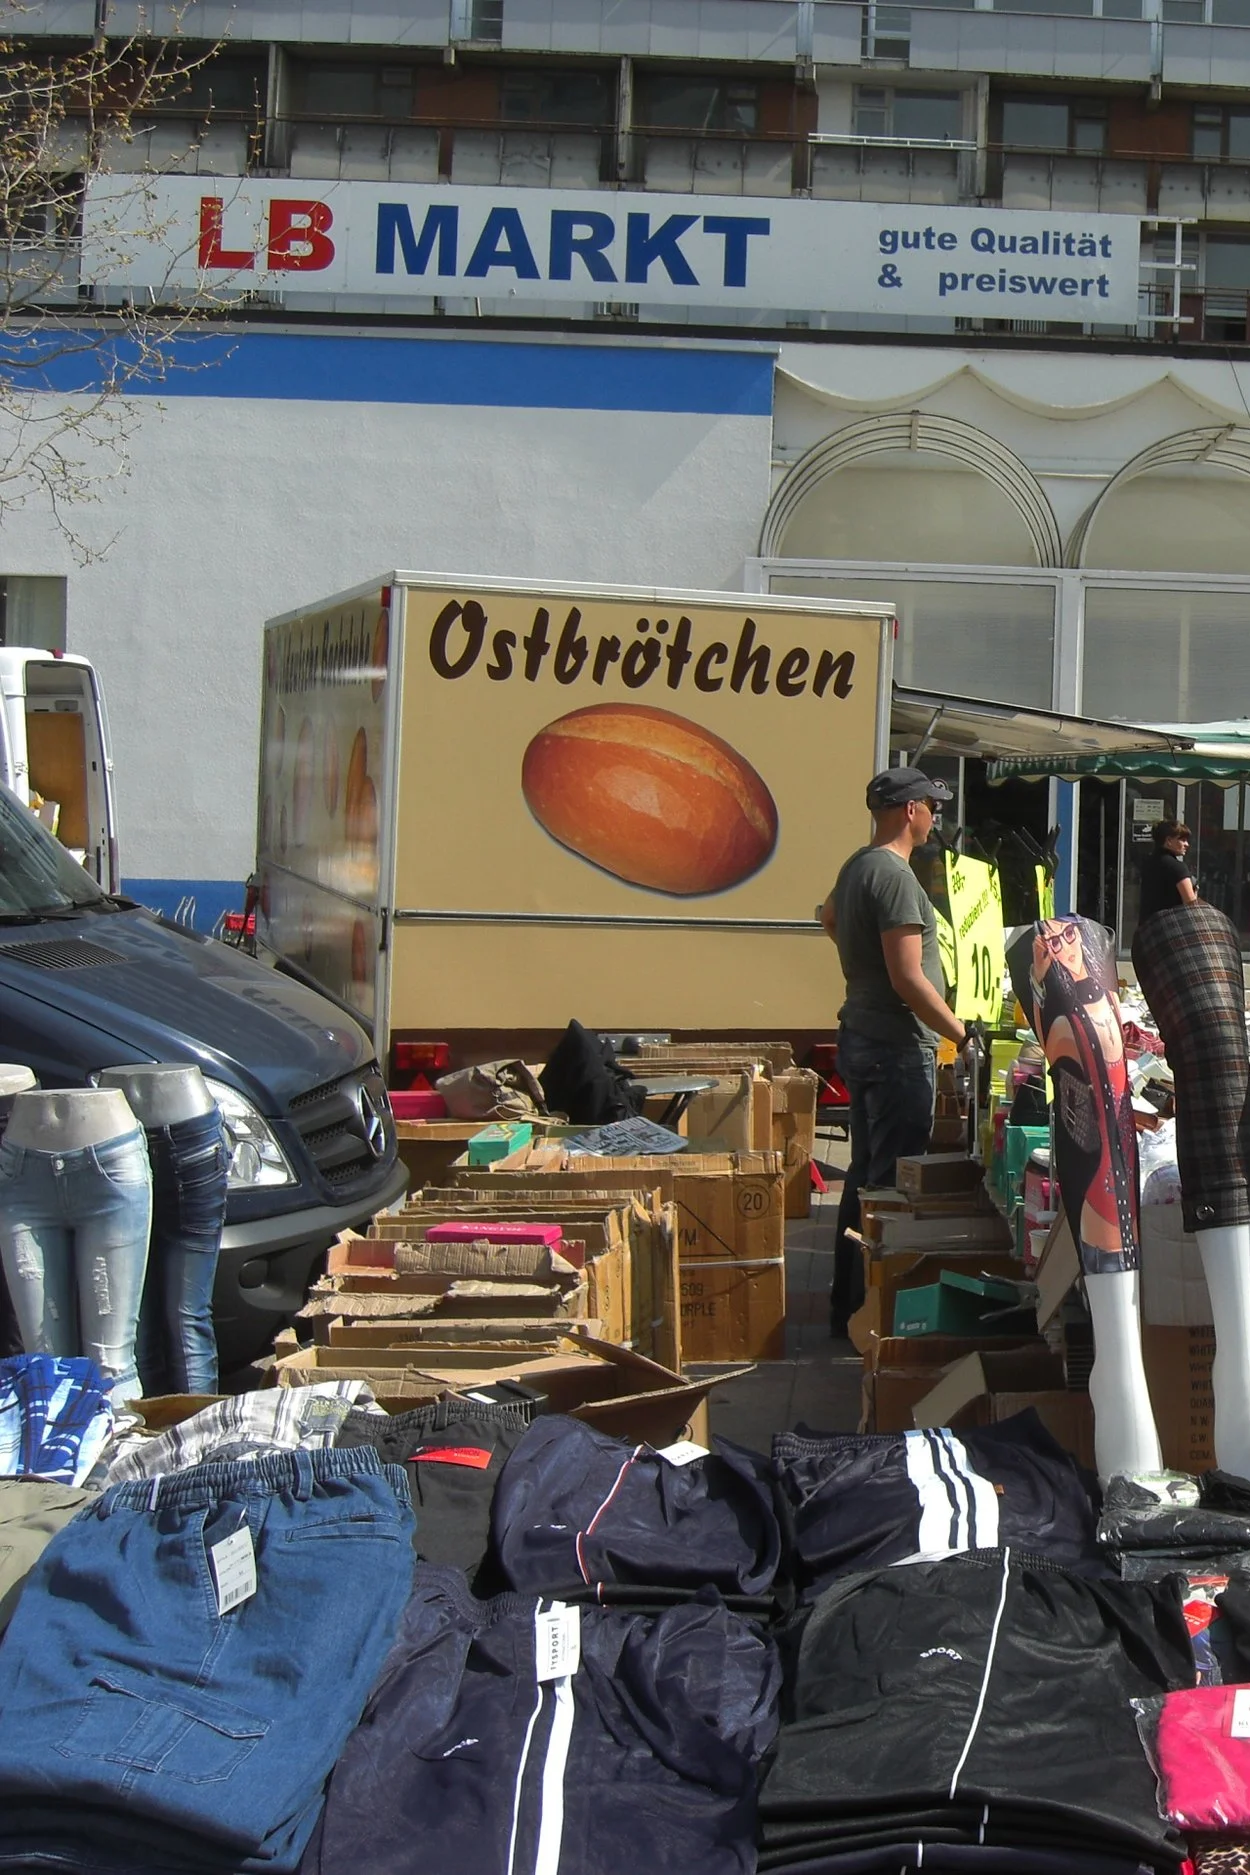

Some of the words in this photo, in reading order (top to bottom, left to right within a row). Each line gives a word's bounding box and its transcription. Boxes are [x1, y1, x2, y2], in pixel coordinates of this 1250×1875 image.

[198, 197, 334, 271] LB
[375, 203, 770, 287] MARKT
[879, 227, 958, 255] gute
[970, 227, 1112, 258] Qualität
[878, 263, 902, 288] &
[939, 271, 1110, 299] preiswert
[428, 599, 856, 699] Ostbrötchen
[743, 1193, 763, 1211] 20
[680, 1302, 716, 1317] URPLE
[1190, 1362, 1213, 1373] WHIT
[1191, 1380, 1213, 1391] WHIT
[920, 1646, 963, 1661] SPORT
